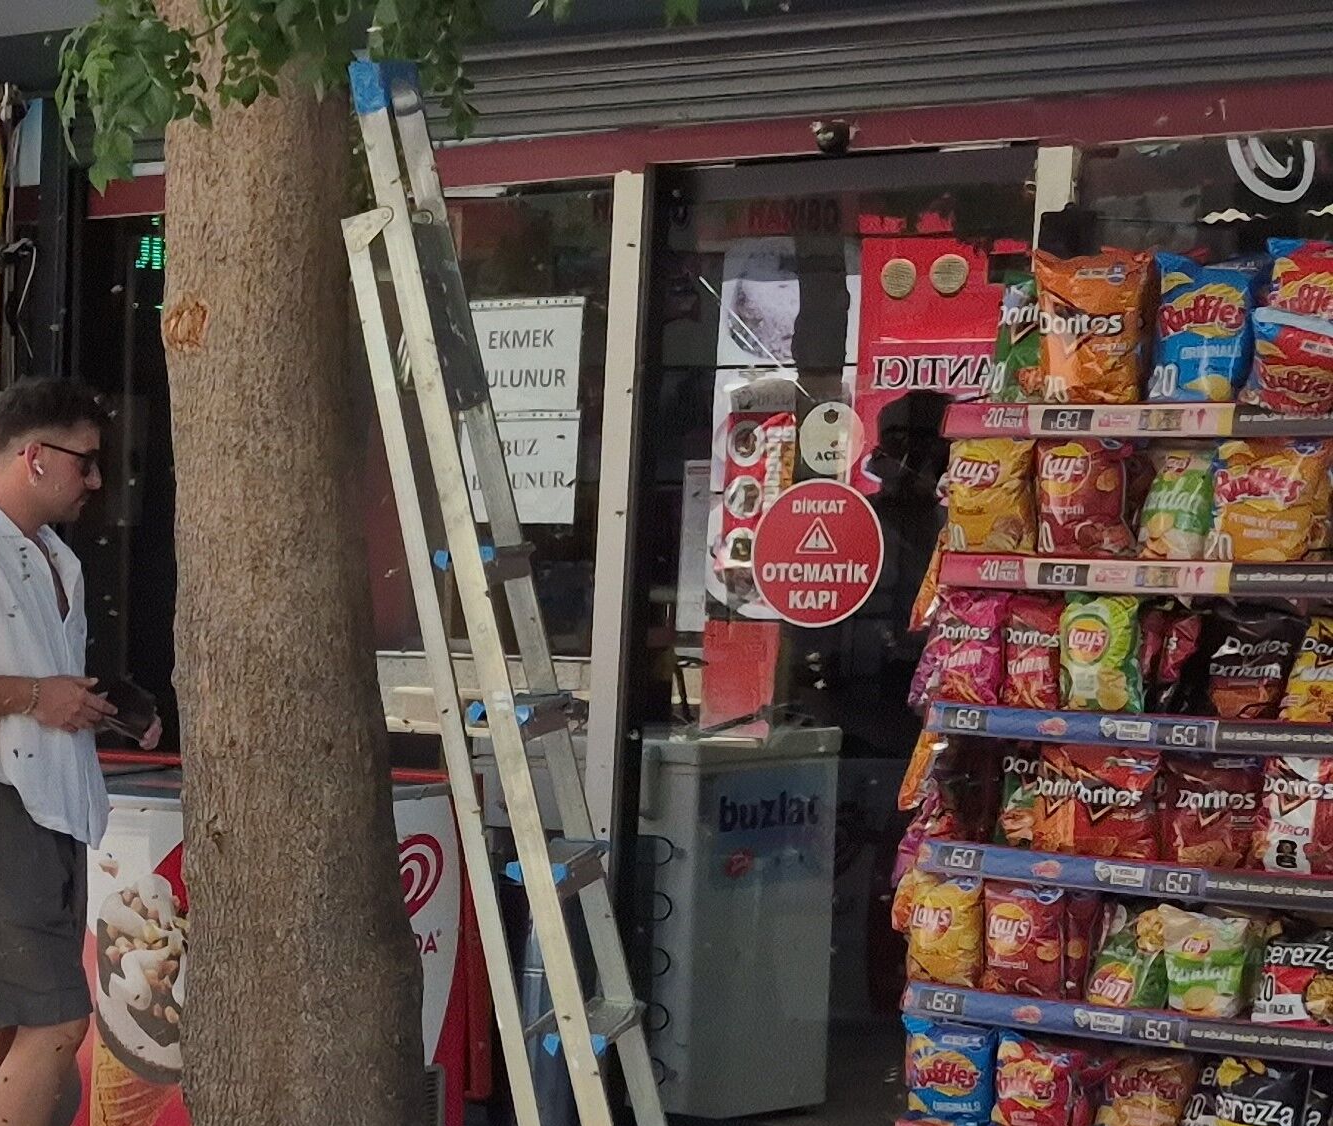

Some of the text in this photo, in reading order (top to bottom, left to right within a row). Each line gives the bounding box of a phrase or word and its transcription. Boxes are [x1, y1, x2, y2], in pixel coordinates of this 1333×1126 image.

[1039, 311, 1123, 335] Doritos
[1160, 293, 1247, 339] Ruffles
[488, 328, 555, 350] EKMEK
[485, 368, 566, 389] ULUNUR
[792, 498, 848, 516] DİKKAT
[761, 559, 869, 585] OTOMATİK
[788, 589, 838, 611] KAPI
[937, 623, 991, 641] Doritos
[1175, 789, 1257, 810] Doritos
